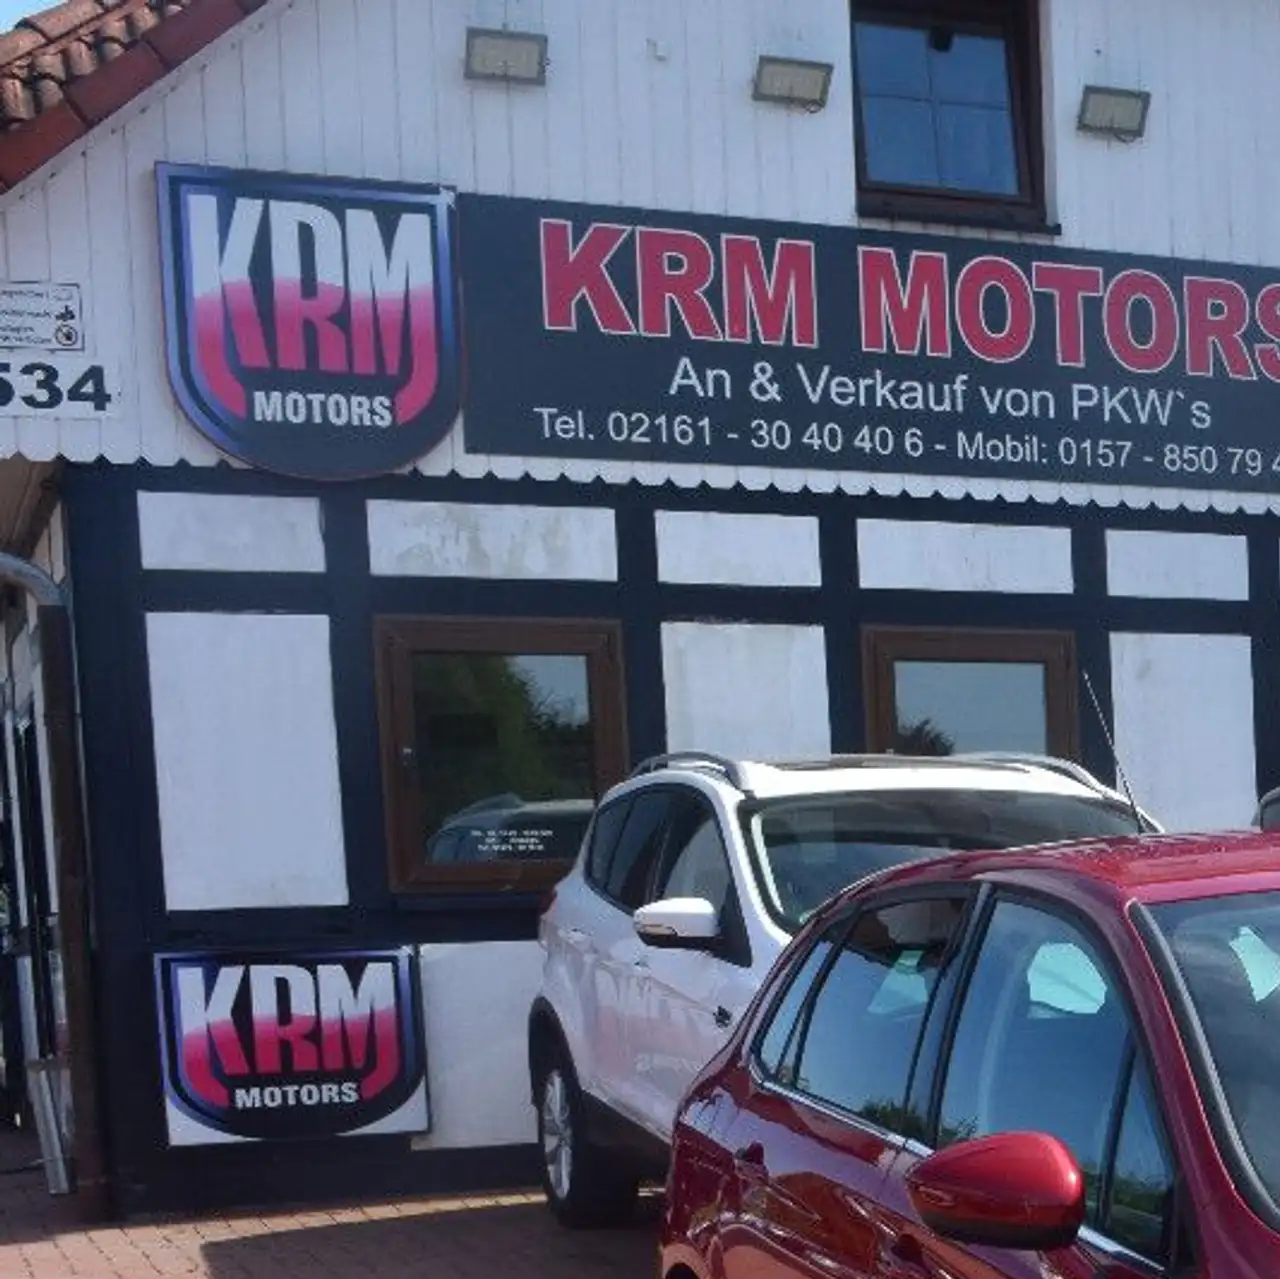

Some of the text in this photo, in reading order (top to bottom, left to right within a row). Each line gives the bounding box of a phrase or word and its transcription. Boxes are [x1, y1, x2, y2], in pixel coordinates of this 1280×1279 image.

[187, 194, 438, 424] KRM
[540, 218, 819, 348] KRM
[253, 391, 393, 428] MOTORS
[669, 357, 731, 400] An
[748, 361, 782, 402] &
[796, 364, 968, 412] Verkauf
[979, 386, 1055, 419] von
[533, 407, 594, 441] Tel.
[608, 411, 711, 446] 02161
[750, 421, 791, 450] 30
[803, 423, 842, 452] 40
[855, 425, 894, 456] 40
[904, 429, 923, 458] 6
[957, 431, 1048, 464] Mobil:
[1059, 437, 1132, 468] 0157
[1164, 443, 1217, 474] 850
[1227, 448, 1262, 477] 79
[177, 962, 399, 1107] KRM
[235, 1082, 360, 1109] MOTORS
